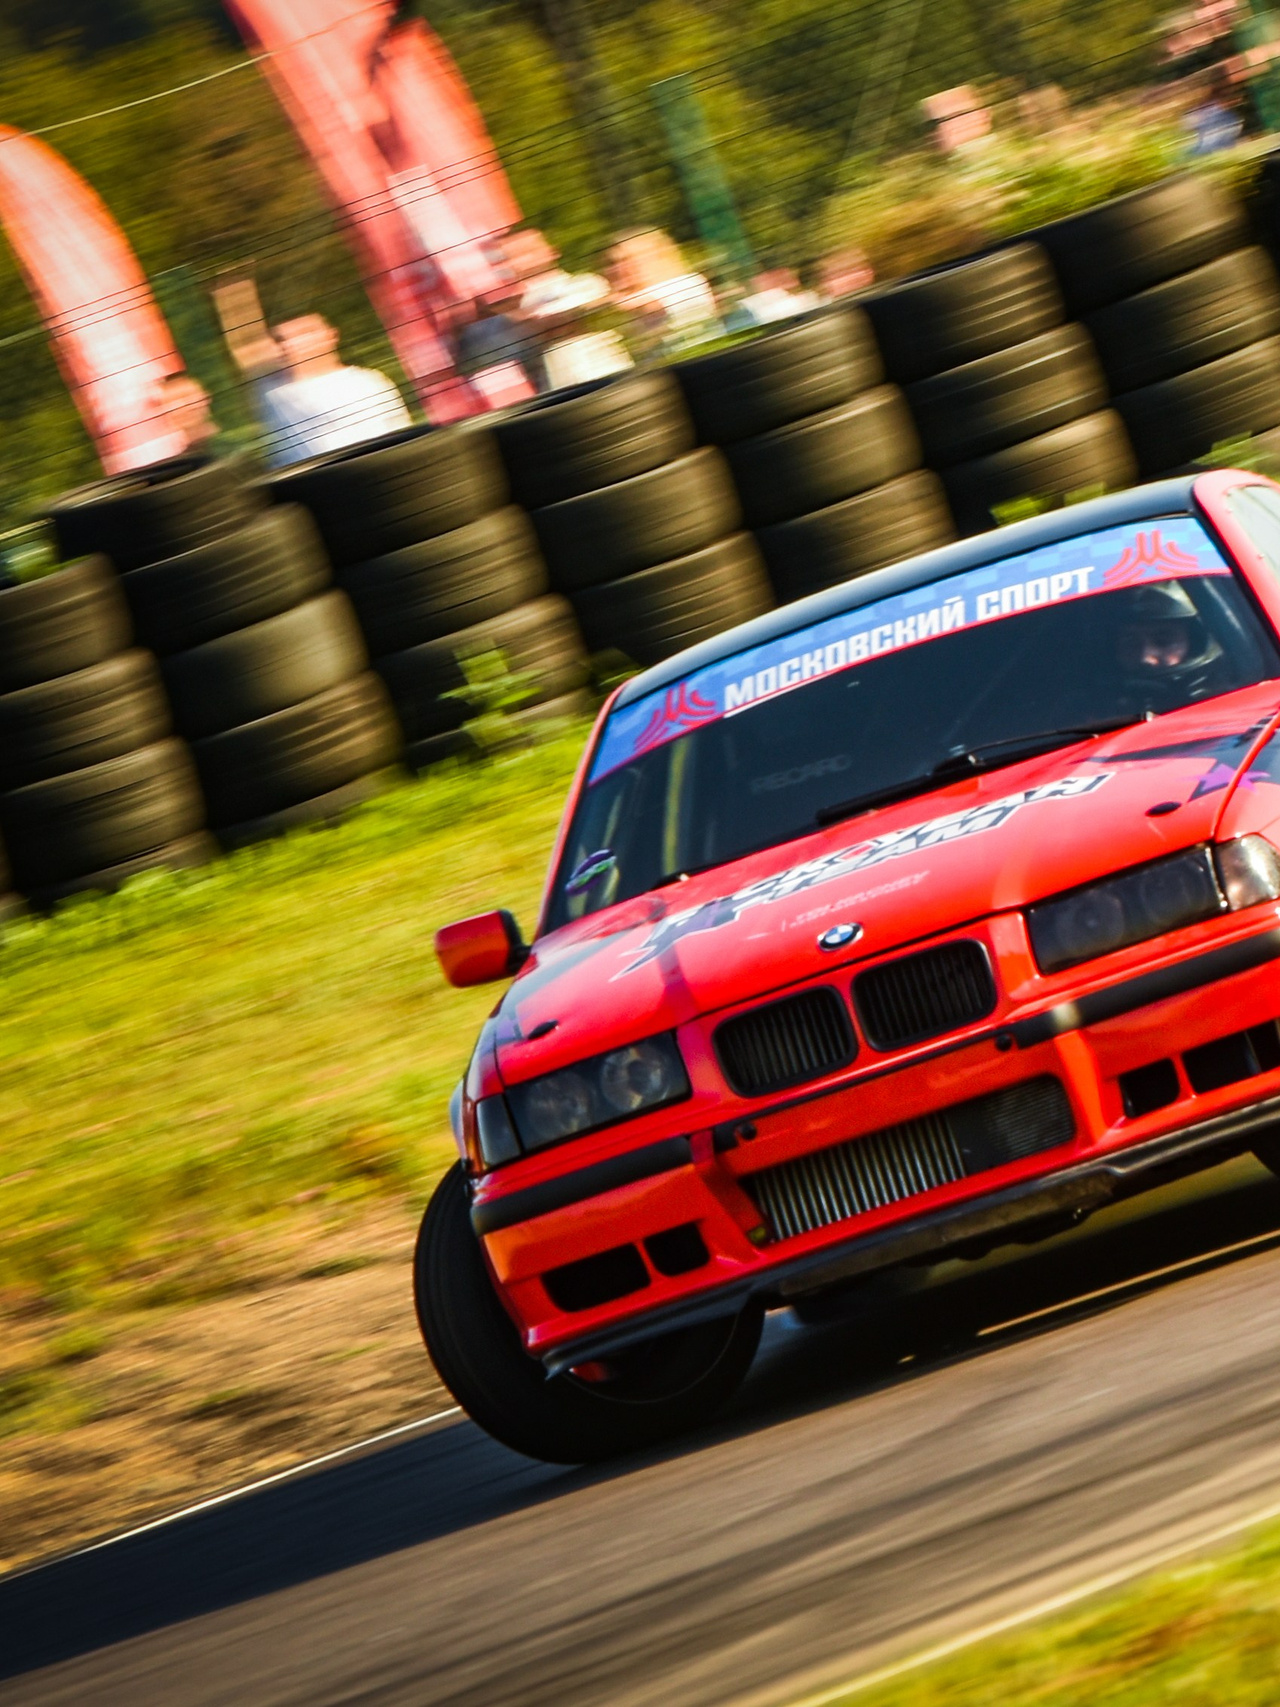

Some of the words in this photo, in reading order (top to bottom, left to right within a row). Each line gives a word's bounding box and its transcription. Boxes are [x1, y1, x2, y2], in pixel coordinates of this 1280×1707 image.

[723, 596, 966, 710] МОСКОВСКИЙ
[976, 566, 1095, 621] СПОРТ
[648, 846, 852, 946] FCK
[771, 806, 1004, 900] TEAM
